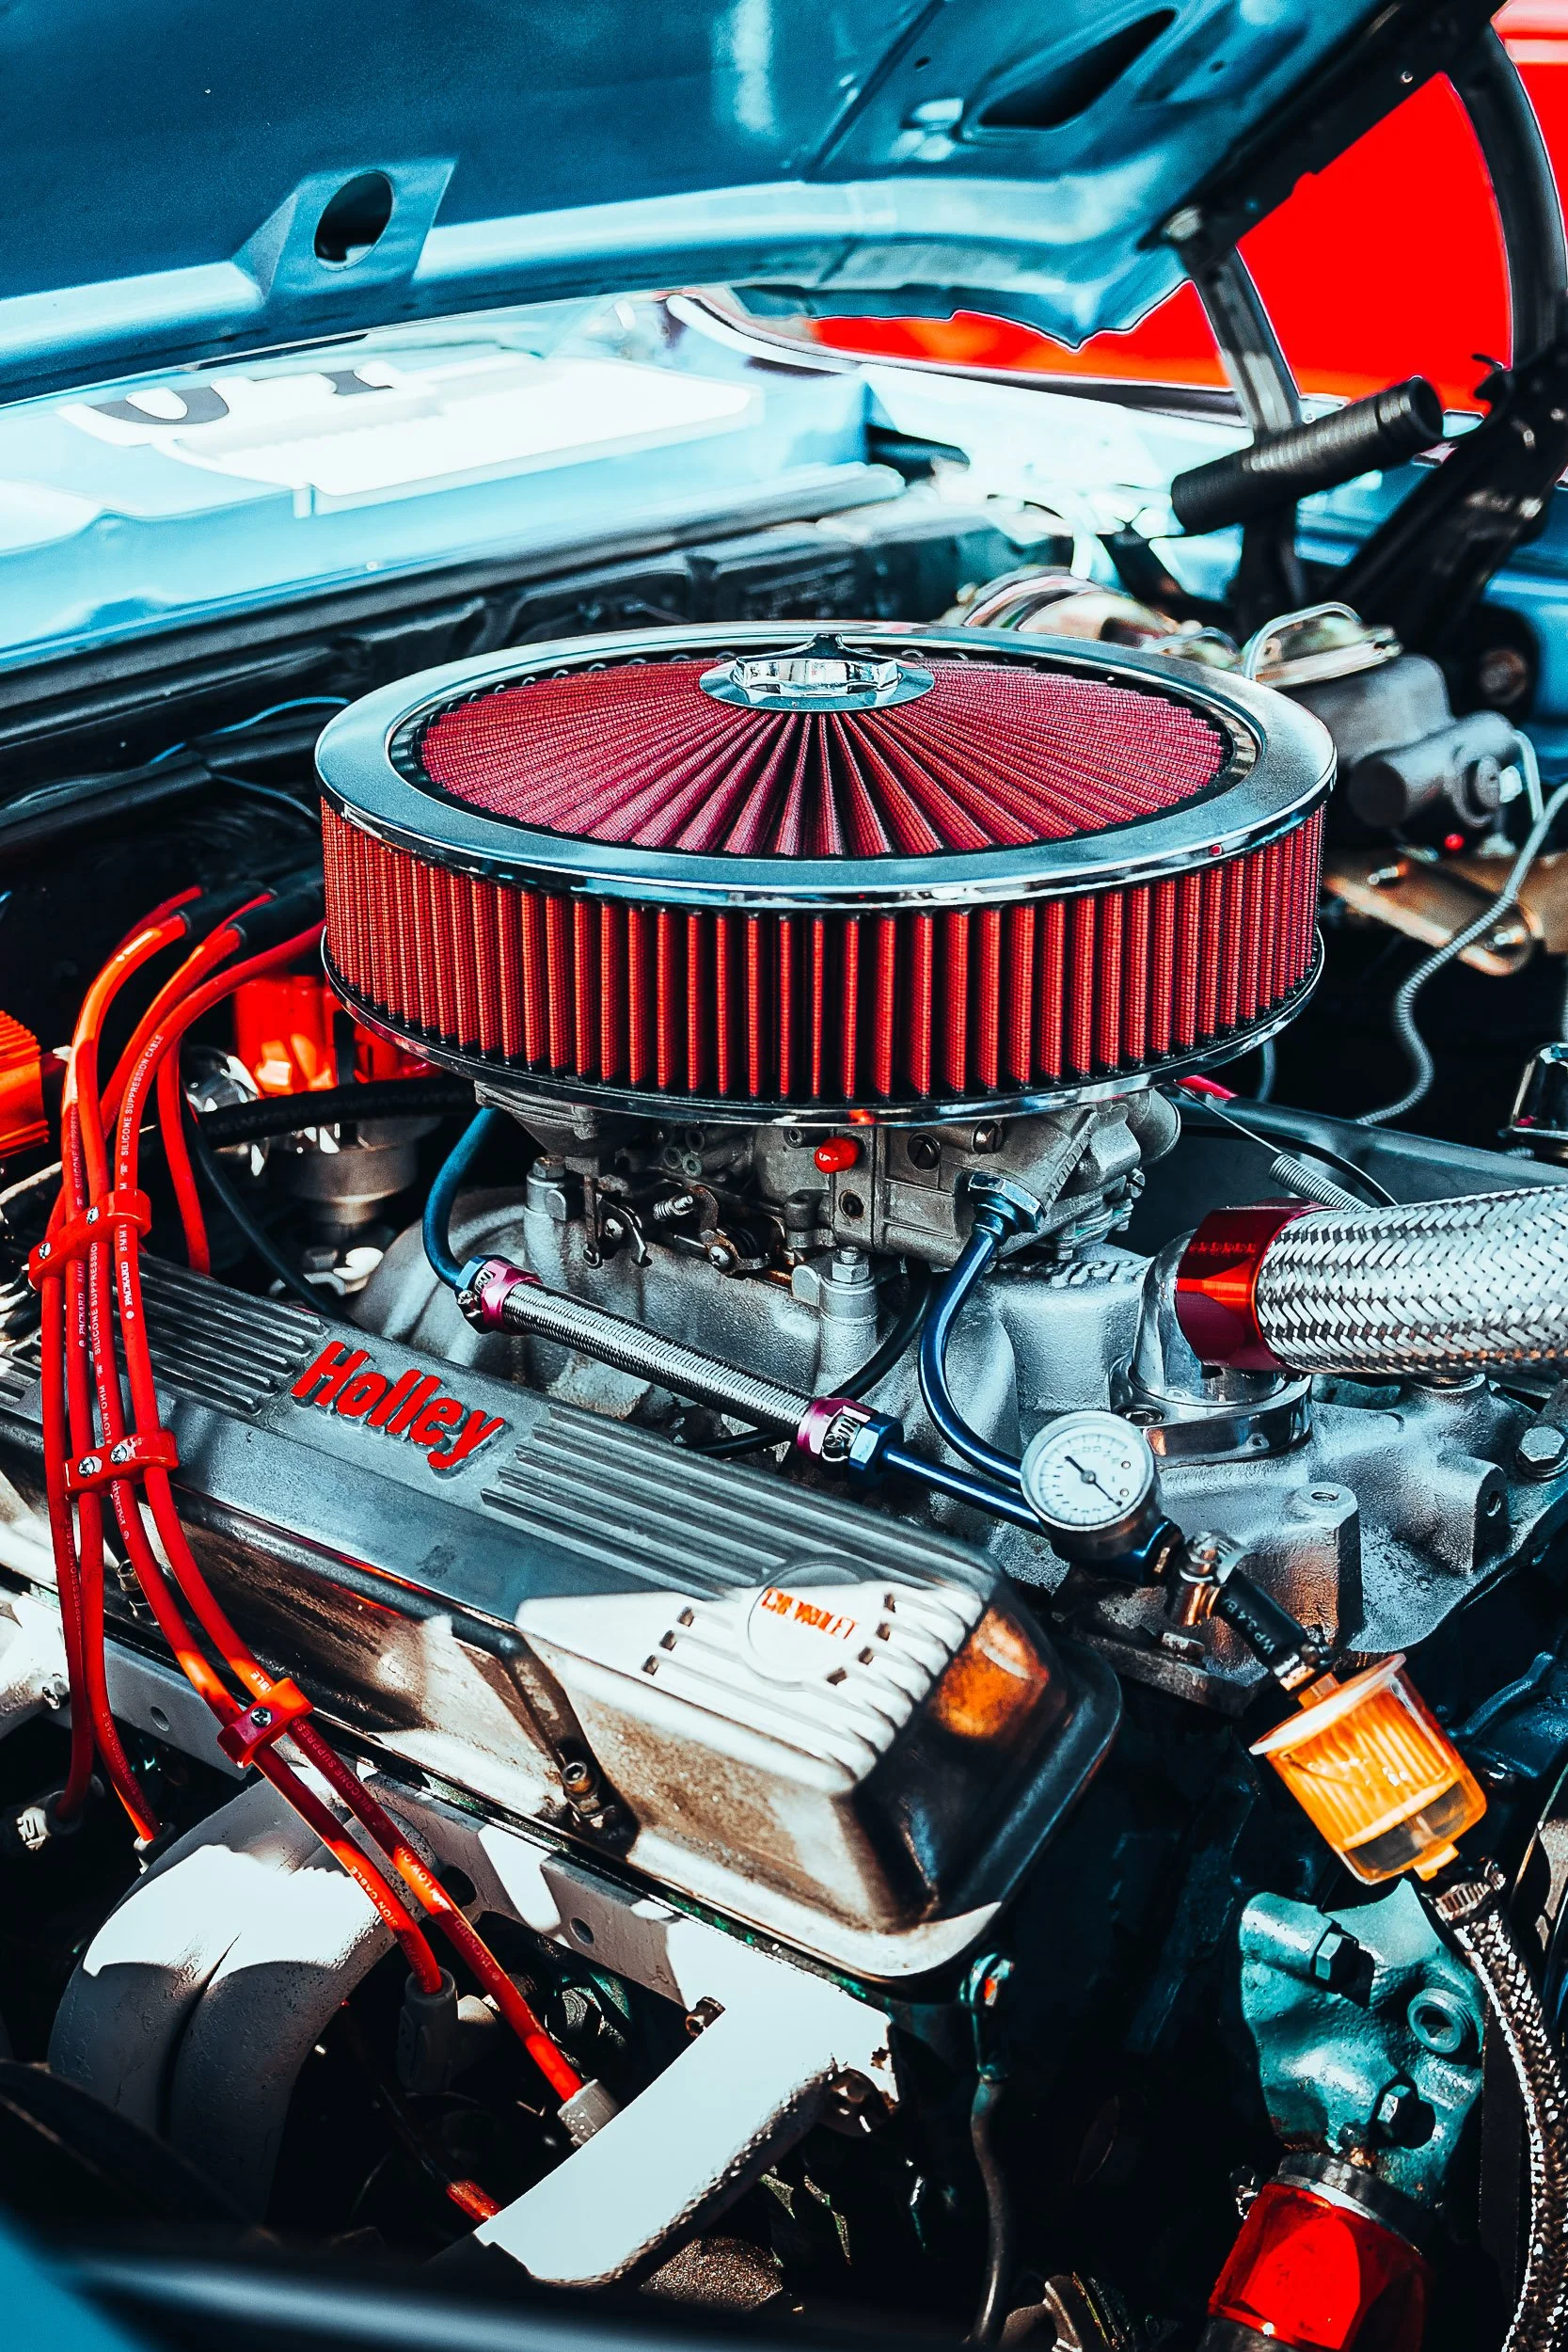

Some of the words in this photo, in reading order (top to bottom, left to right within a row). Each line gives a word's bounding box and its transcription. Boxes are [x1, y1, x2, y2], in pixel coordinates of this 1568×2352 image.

[145, 1034, 164, 1057] CABLE
[125, 1058, 150, 1114] SUPPRESSION
[120, 1117, 133, 1156] SILICONE
[119, 1230, 128, 1252] 8MM
[120, 1262, 133, 1307] PACKARD
[91, 1308, 101, 1355] SILICONE
[99, 1385, 108, 1409] OHM
[291, 1340, 505, 1470] Holley
[103, 1413, 112, 1437] LOW
[1254, 1632, 1275, 1655] WP
[292, 1717, 337, 1768] SUPPRESS
[334, 1768, 373, 1814] SILICONE
[396, 1841, 413, 1863] OH
[349, 1866, 378, 1899] CABLE
[411, 1863, 434, 1888] LOW
